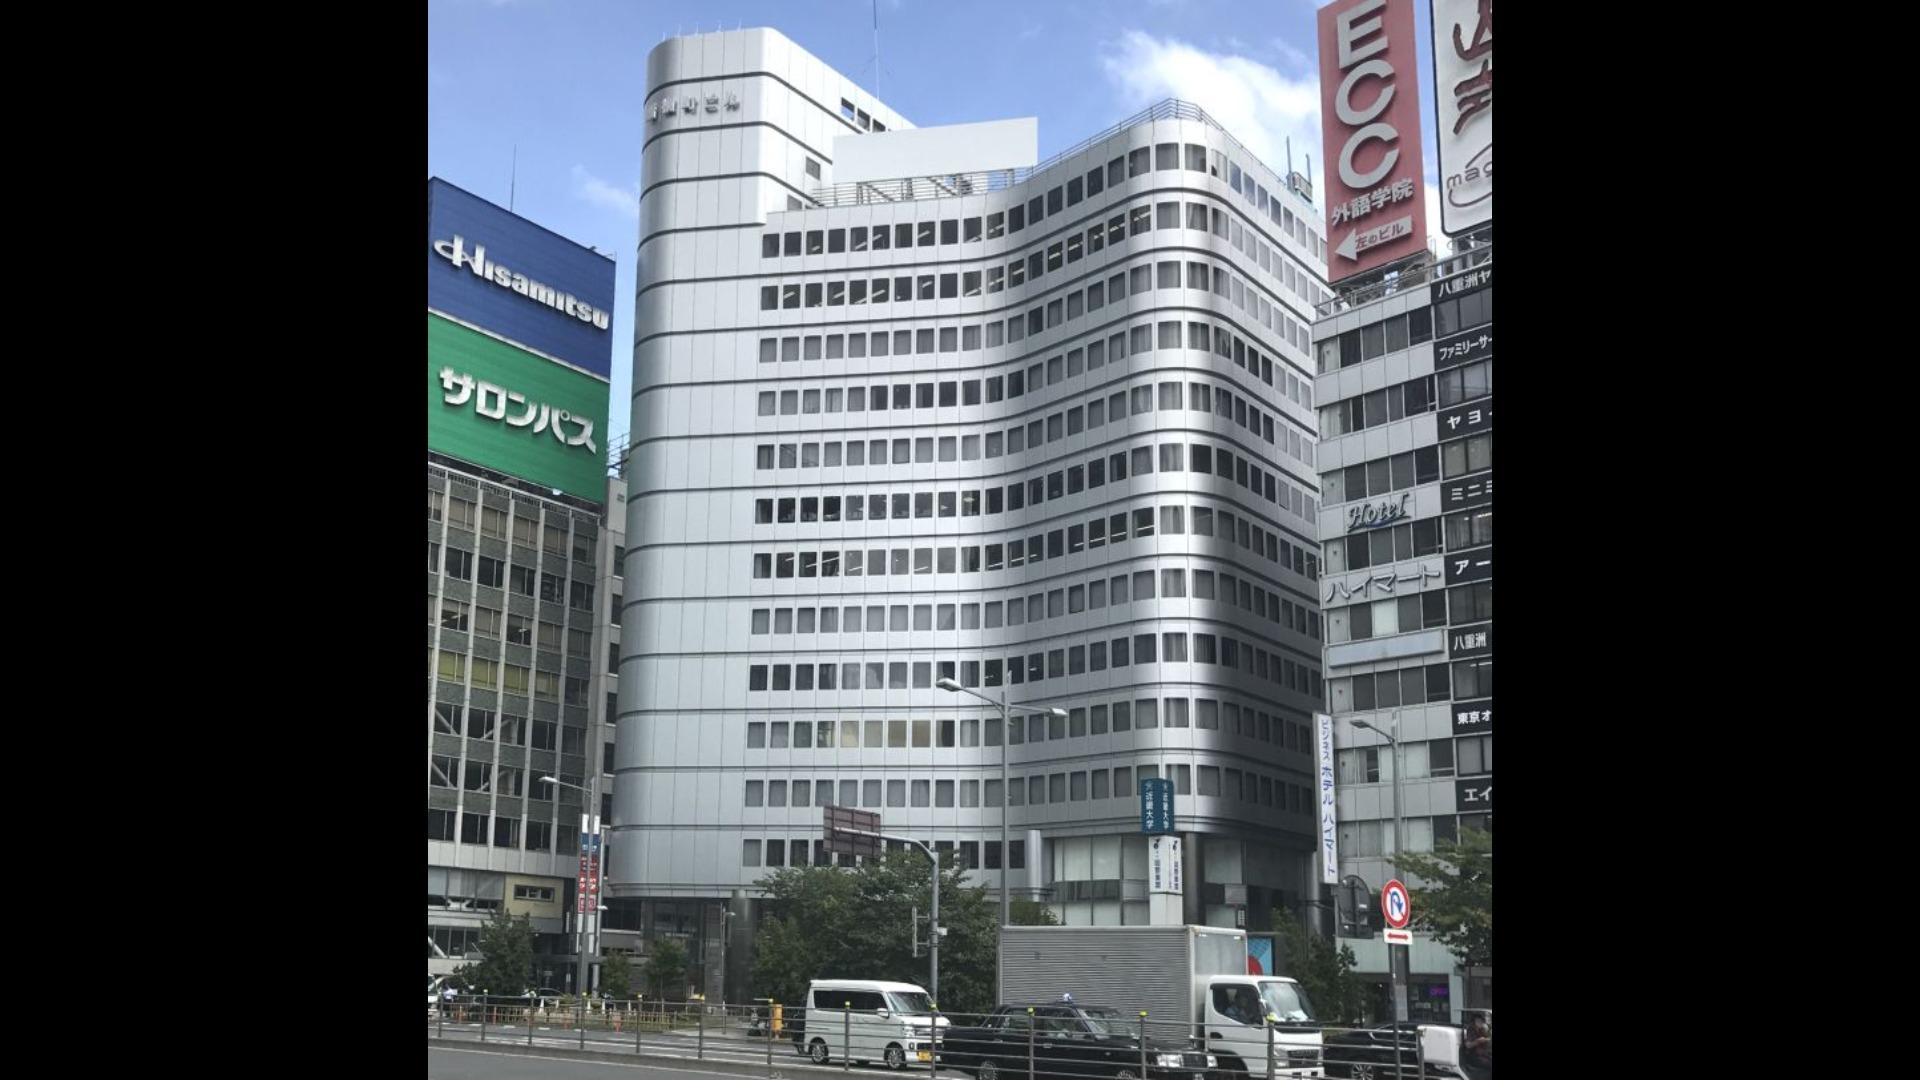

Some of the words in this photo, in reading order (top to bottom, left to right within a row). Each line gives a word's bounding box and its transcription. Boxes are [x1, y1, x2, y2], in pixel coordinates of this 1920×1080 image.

[1335, 0, 1400, 188] ECC
[1332, 178, 1415, 226] 外語学院
[1355, 221, 1404, 250] 左のビル
[434, 234, 609, 331] Hisamitsu
[1438, 269, 1492, 297] 八重洲ヤ
[440, 366, 597, 455] サロンパス
[1447, 409, 1492, 430] ヤヨ
[1348, 492, 1411, 531] Hotel
[1325, 564, 1440, 602] ハイマート
[1454, 631, 1487, 650] 八重洲
